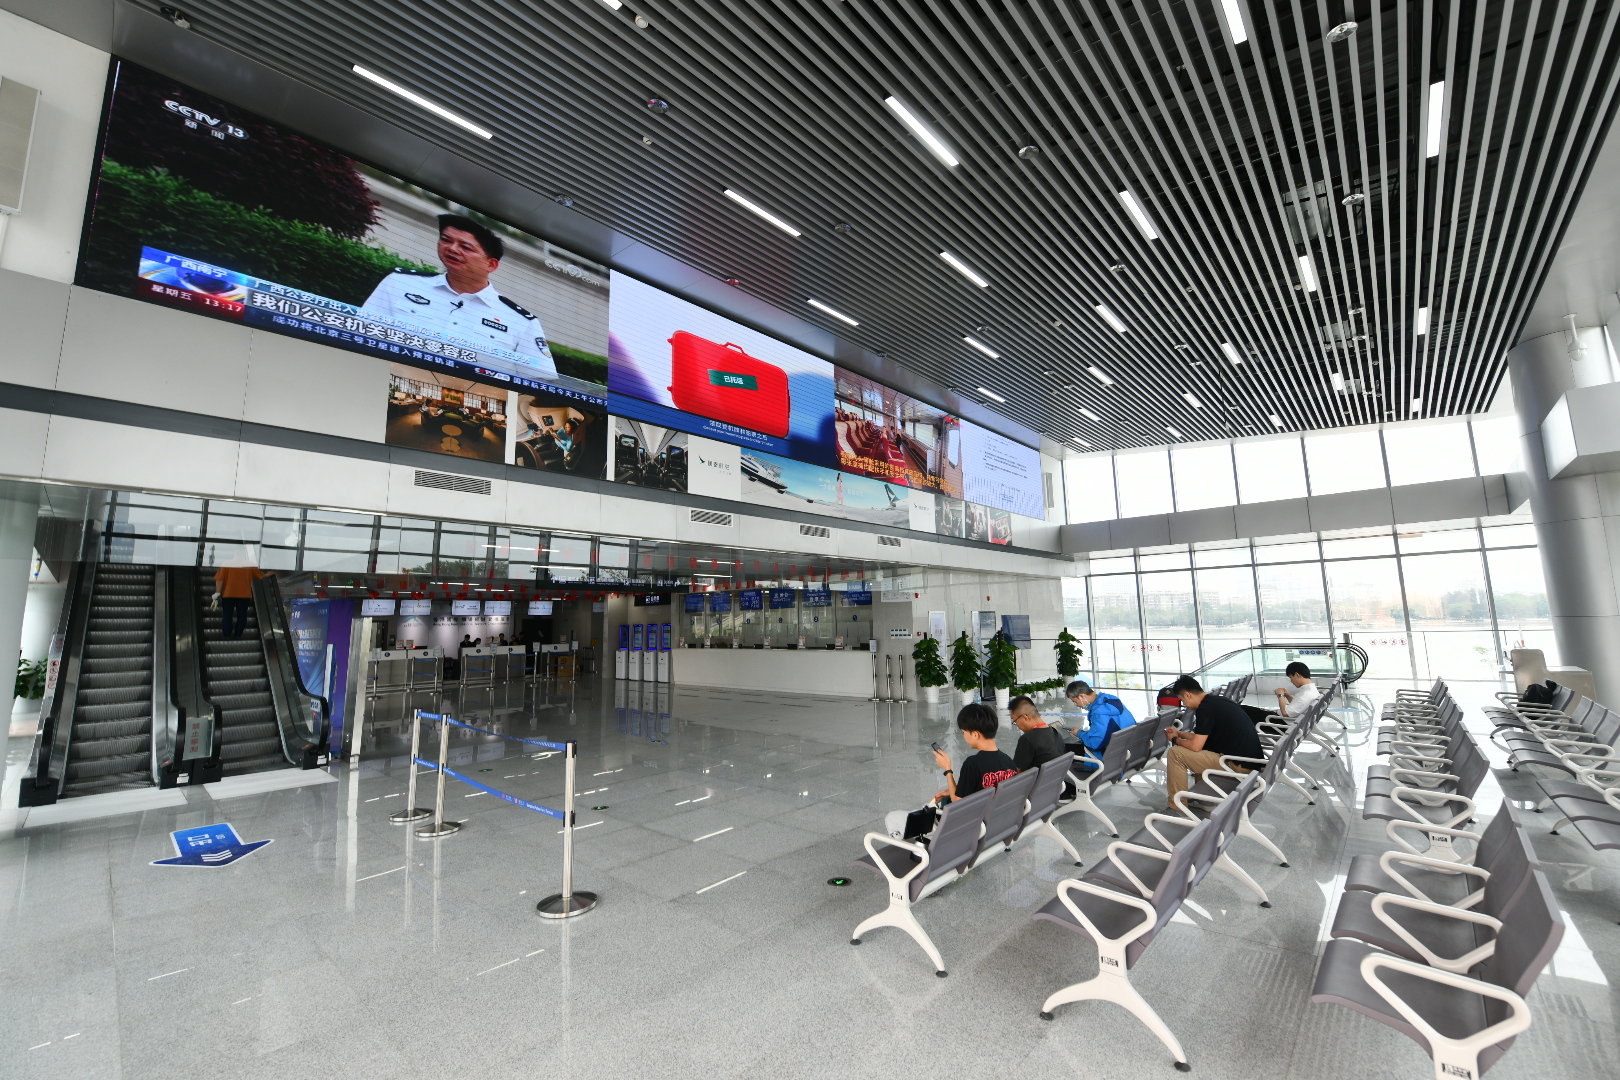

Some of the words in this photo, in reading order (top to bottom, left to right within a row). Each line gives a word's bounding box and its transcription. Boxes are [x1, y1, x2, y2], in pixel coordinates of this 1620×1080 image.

[164, 100, 220, 126] CCTV
[227, 124, 245, 138] 13
[165, 255, 228, 278] 广西南宁
[151, 283, 192, 301] 星期五
[204, 298, 243, 313] 13:17
[252, 292, 479, 363] 我们公安机关坚决零容忍
